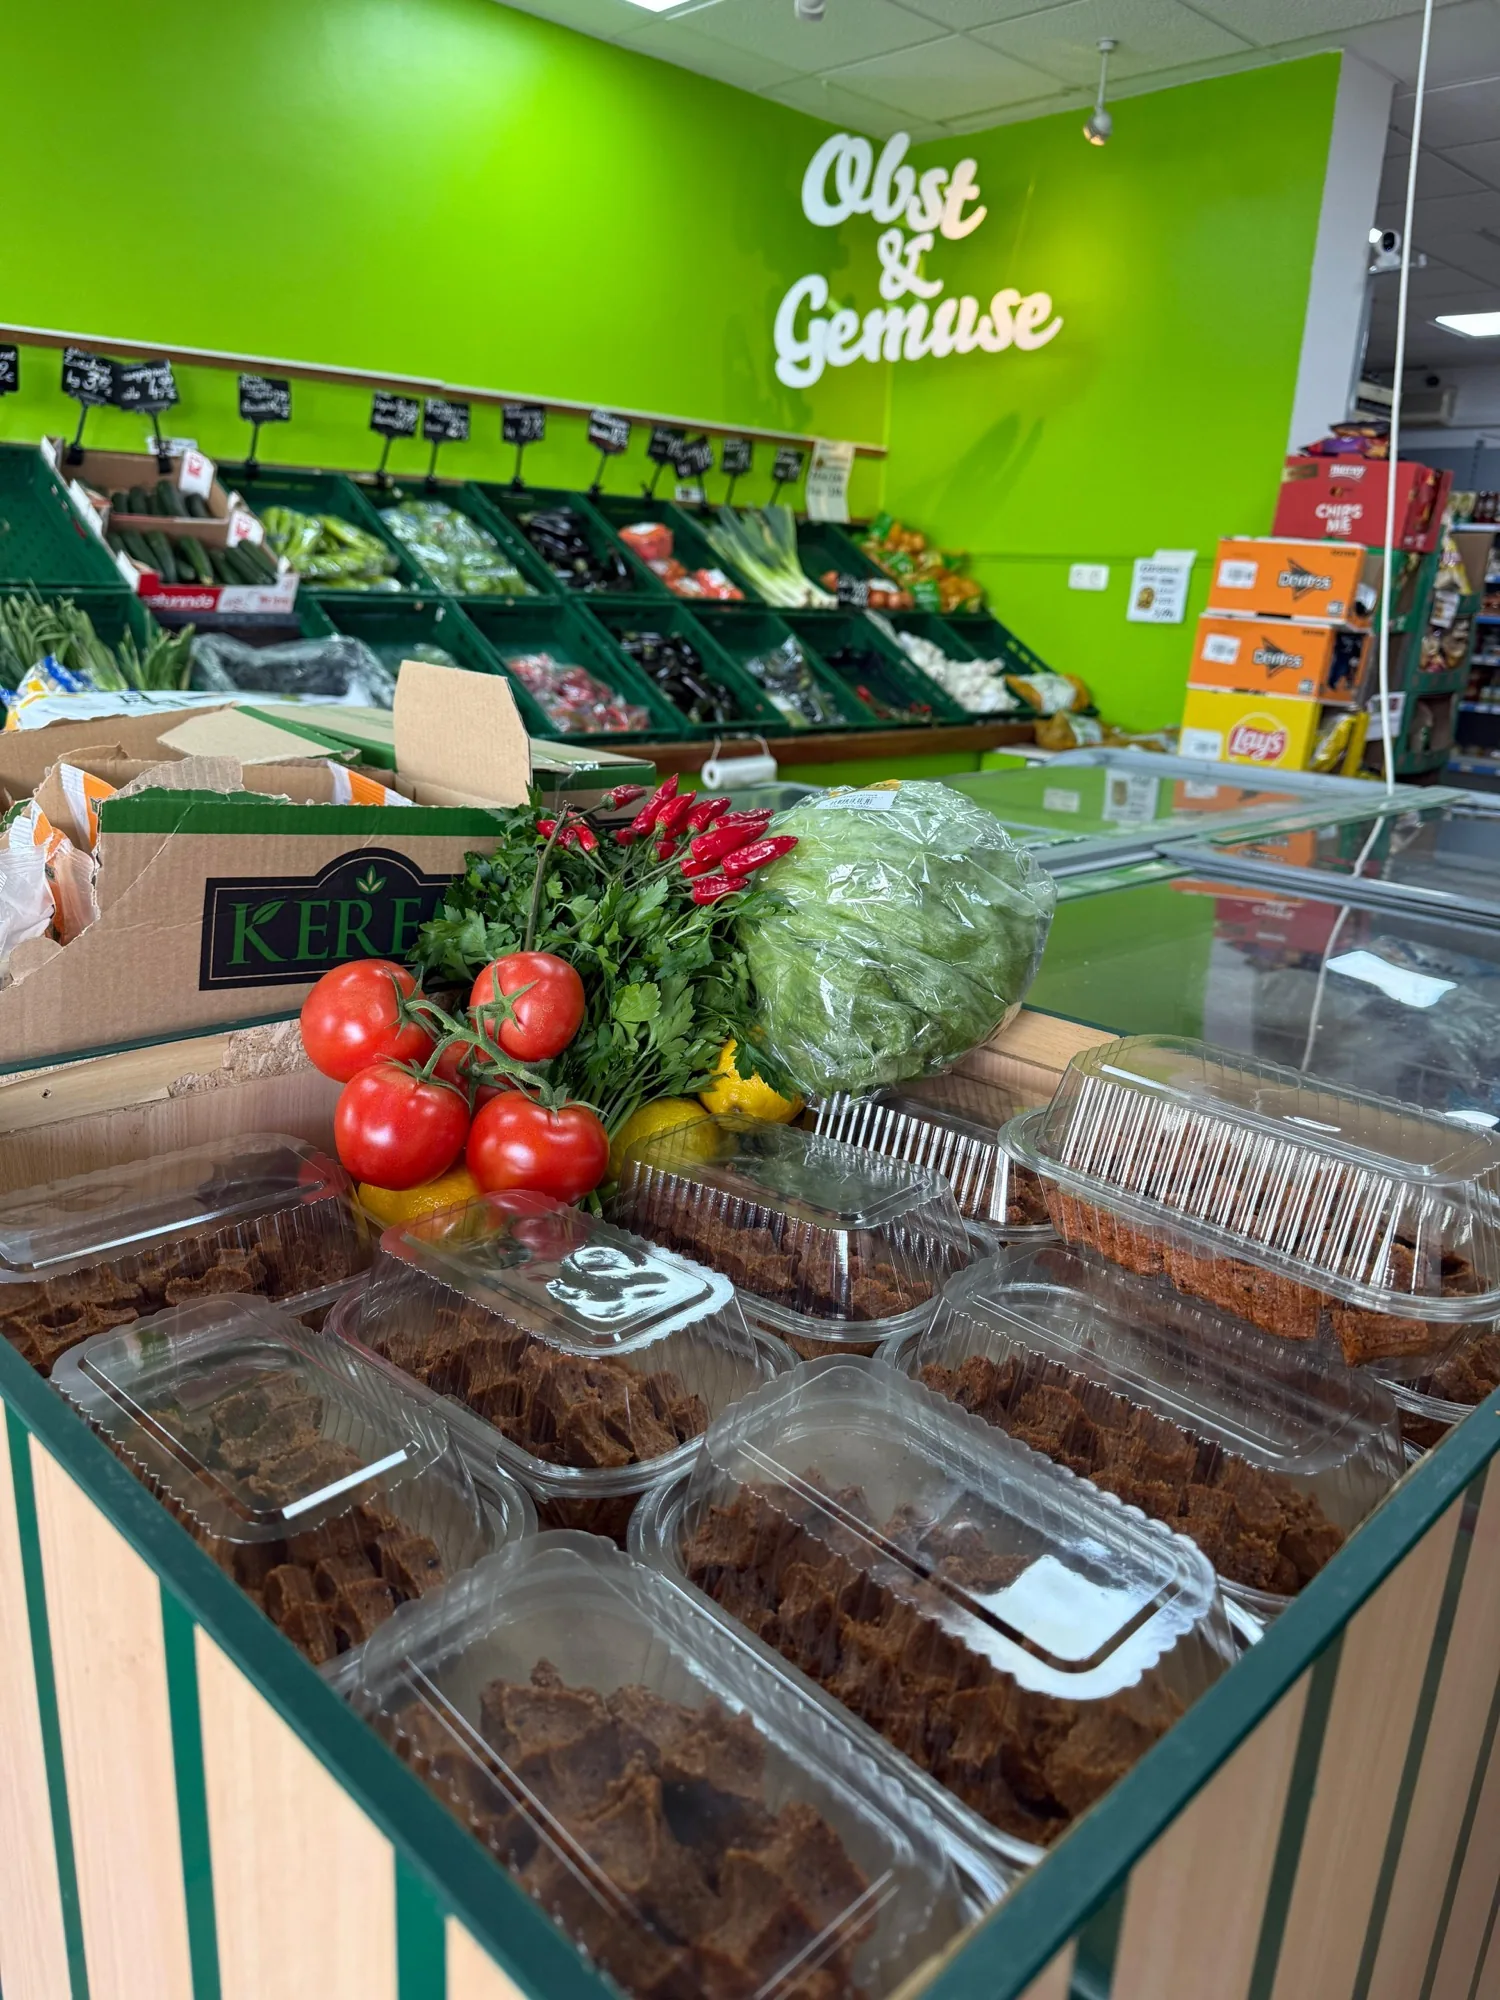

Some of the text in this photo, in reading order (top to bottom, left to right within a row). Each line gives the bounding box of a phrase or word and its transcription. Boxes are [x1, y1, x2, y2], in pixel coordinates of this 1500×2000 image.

[802, 131, 988, 240] Obst
[877, 228, 944, 300] &
[1315, 503, 1363, 519] CHIPS
[1326, 517, 1352, 534] ME
[1278, 571, 1332, 590] Doritos
[1253, 648, 1303, 669] Doritos
[1231, 726, 1284, 761] Lay's
[226, 896, 446, 966] KERE
